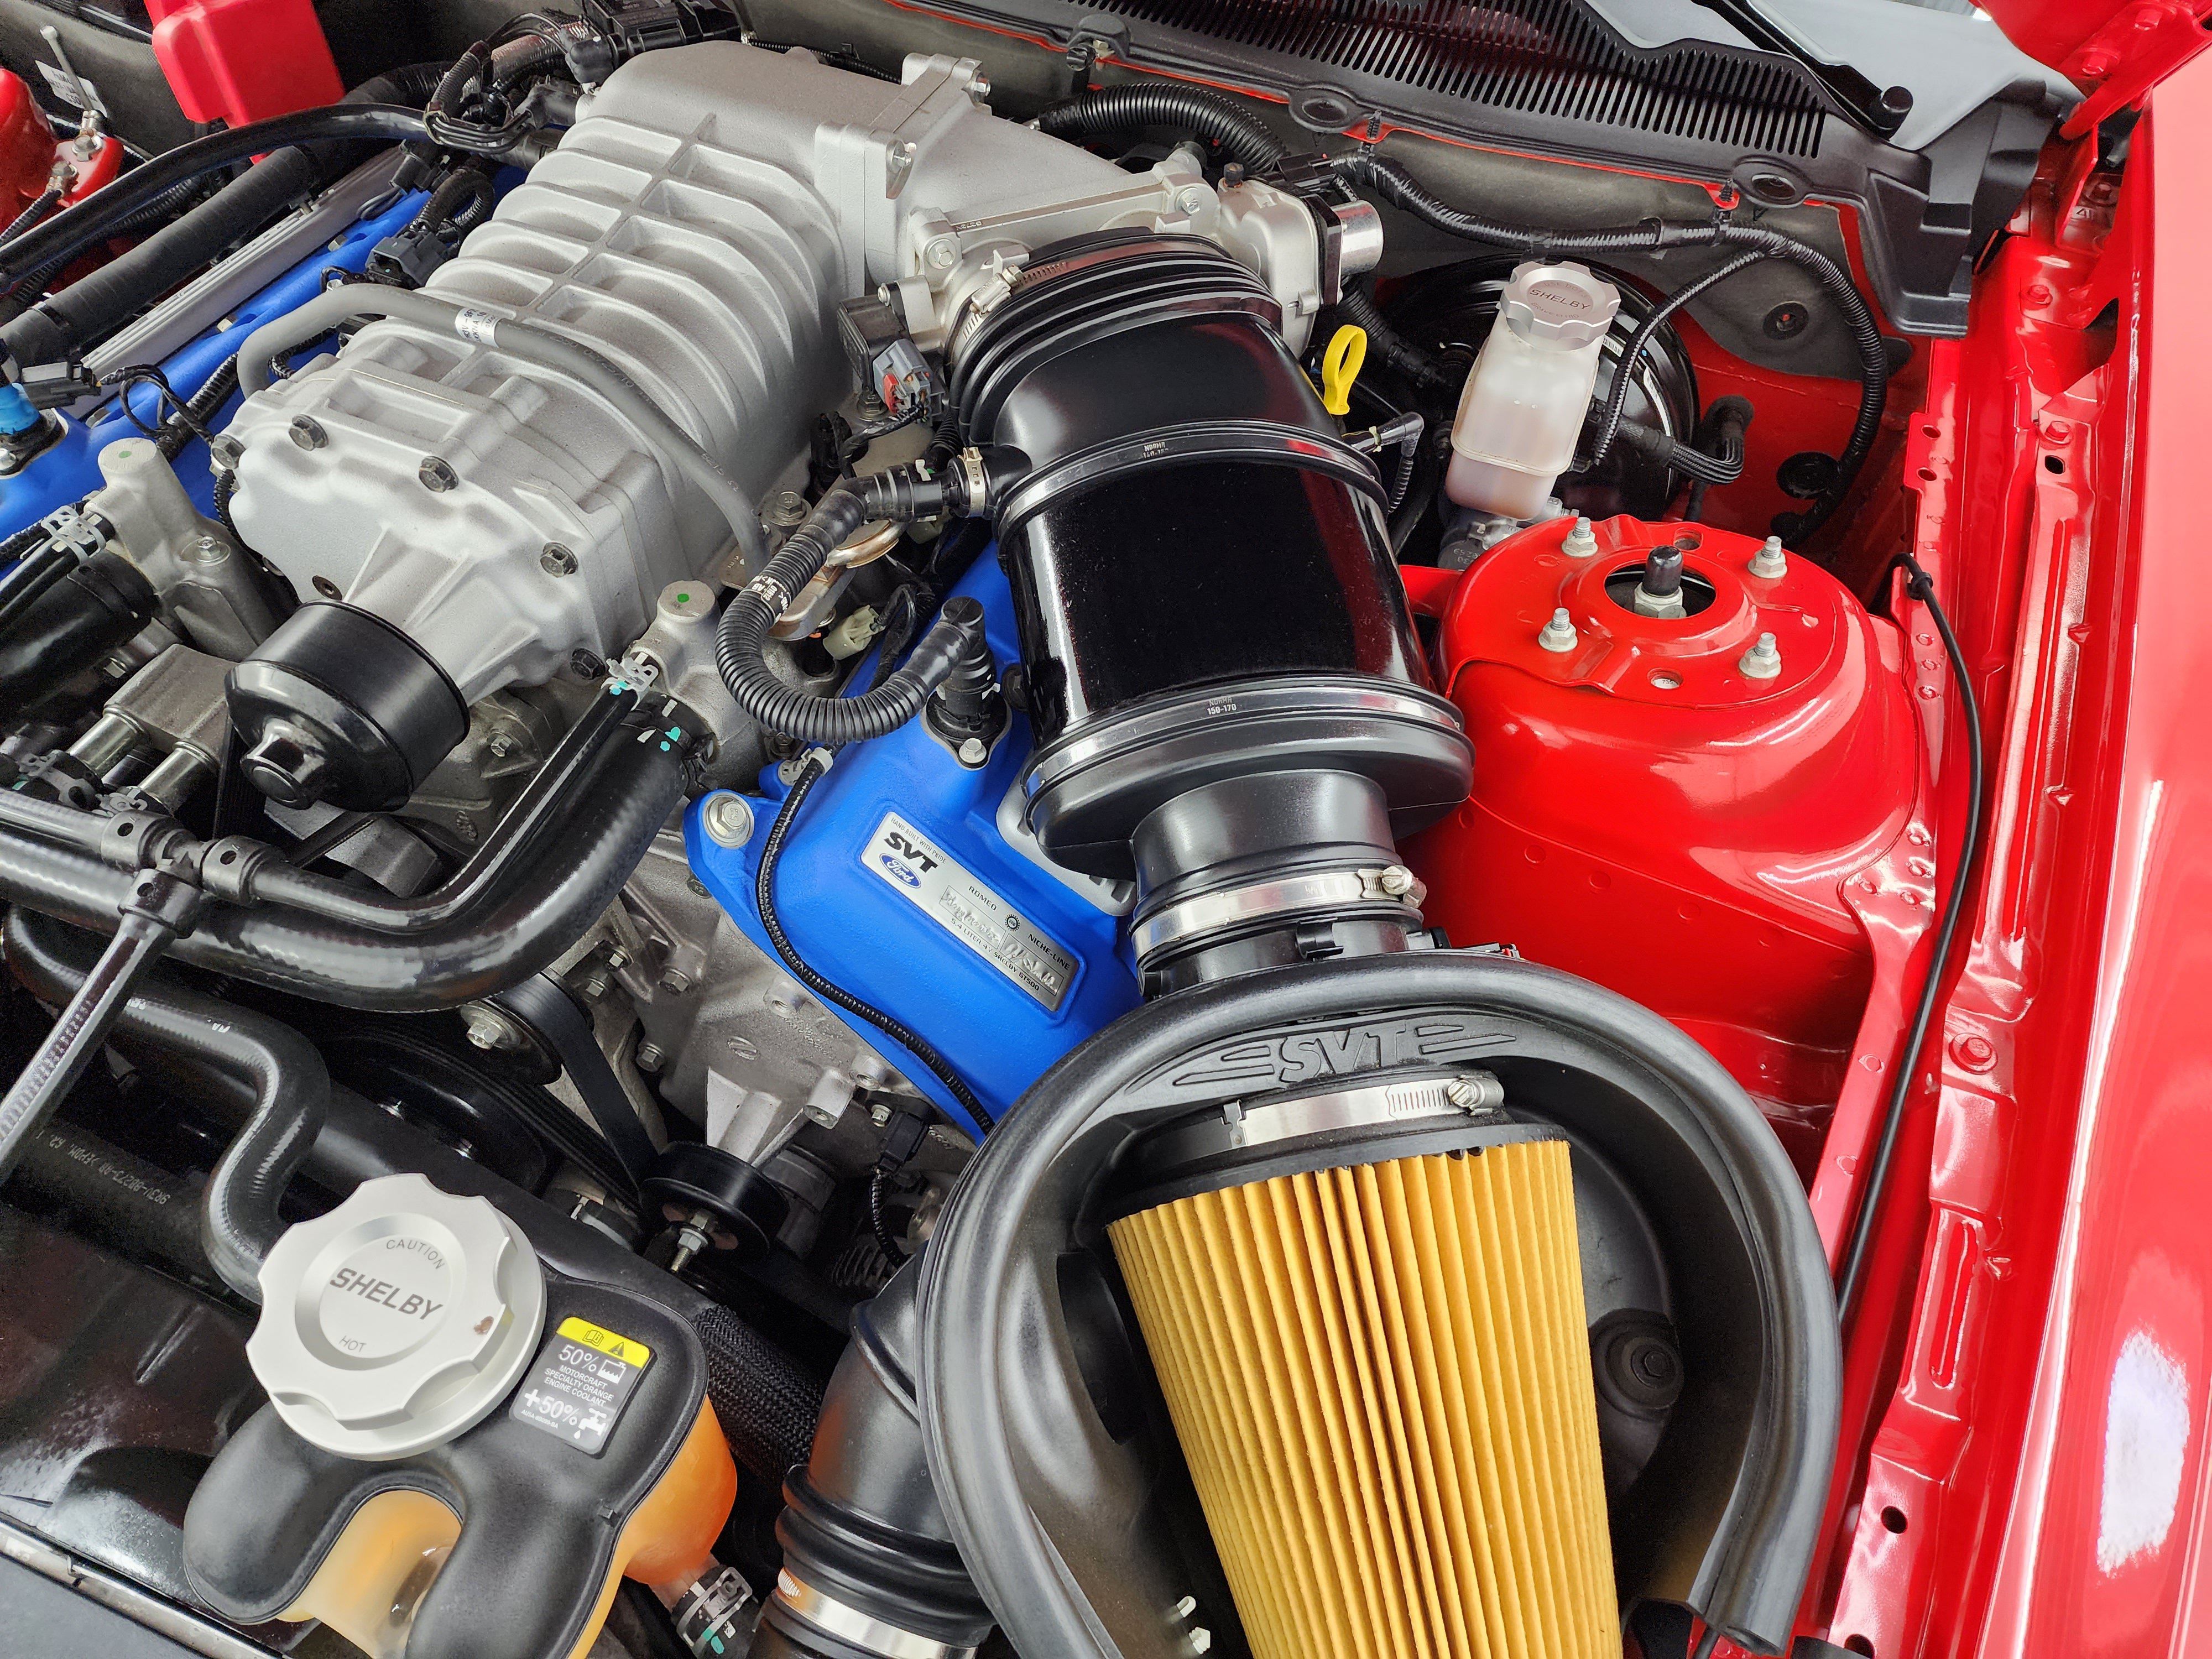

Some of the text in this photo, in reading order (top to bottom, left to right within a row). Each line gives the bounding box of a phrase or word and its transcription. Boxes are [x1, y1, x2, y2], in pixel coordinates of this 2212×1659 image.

[1530, 289, 1591, 310] SHELBY
[1207, 703, 1237, 715] 150-170
[884, 831, 938, 873] SVT
[891, 817, 947, 864] HAND-BUILT WITH PRIDE
[968, 885, 997, 911] ROMEO
[1027, 933, 1071, 970] NICHE-LINE
[951, 917, 1040, 991] 5.4 LITER 4V SHELBY GT500
[1279, 1022, 1407, 1083] SVT
[386, 1239, 445, 1269] CAUTION
[330, 1267, 444, 1320] SHELBY
[338, 1335, 366, 1353] HOT
[559, 1344, 599, 1373] 50%
[544, 1368, 614, 1402] SPECIALTY ORANGE
[544, 1376, 607, 1407] ENGINE COOLANT
[559, 1365, 608, 1390] MOTORCRAFT
